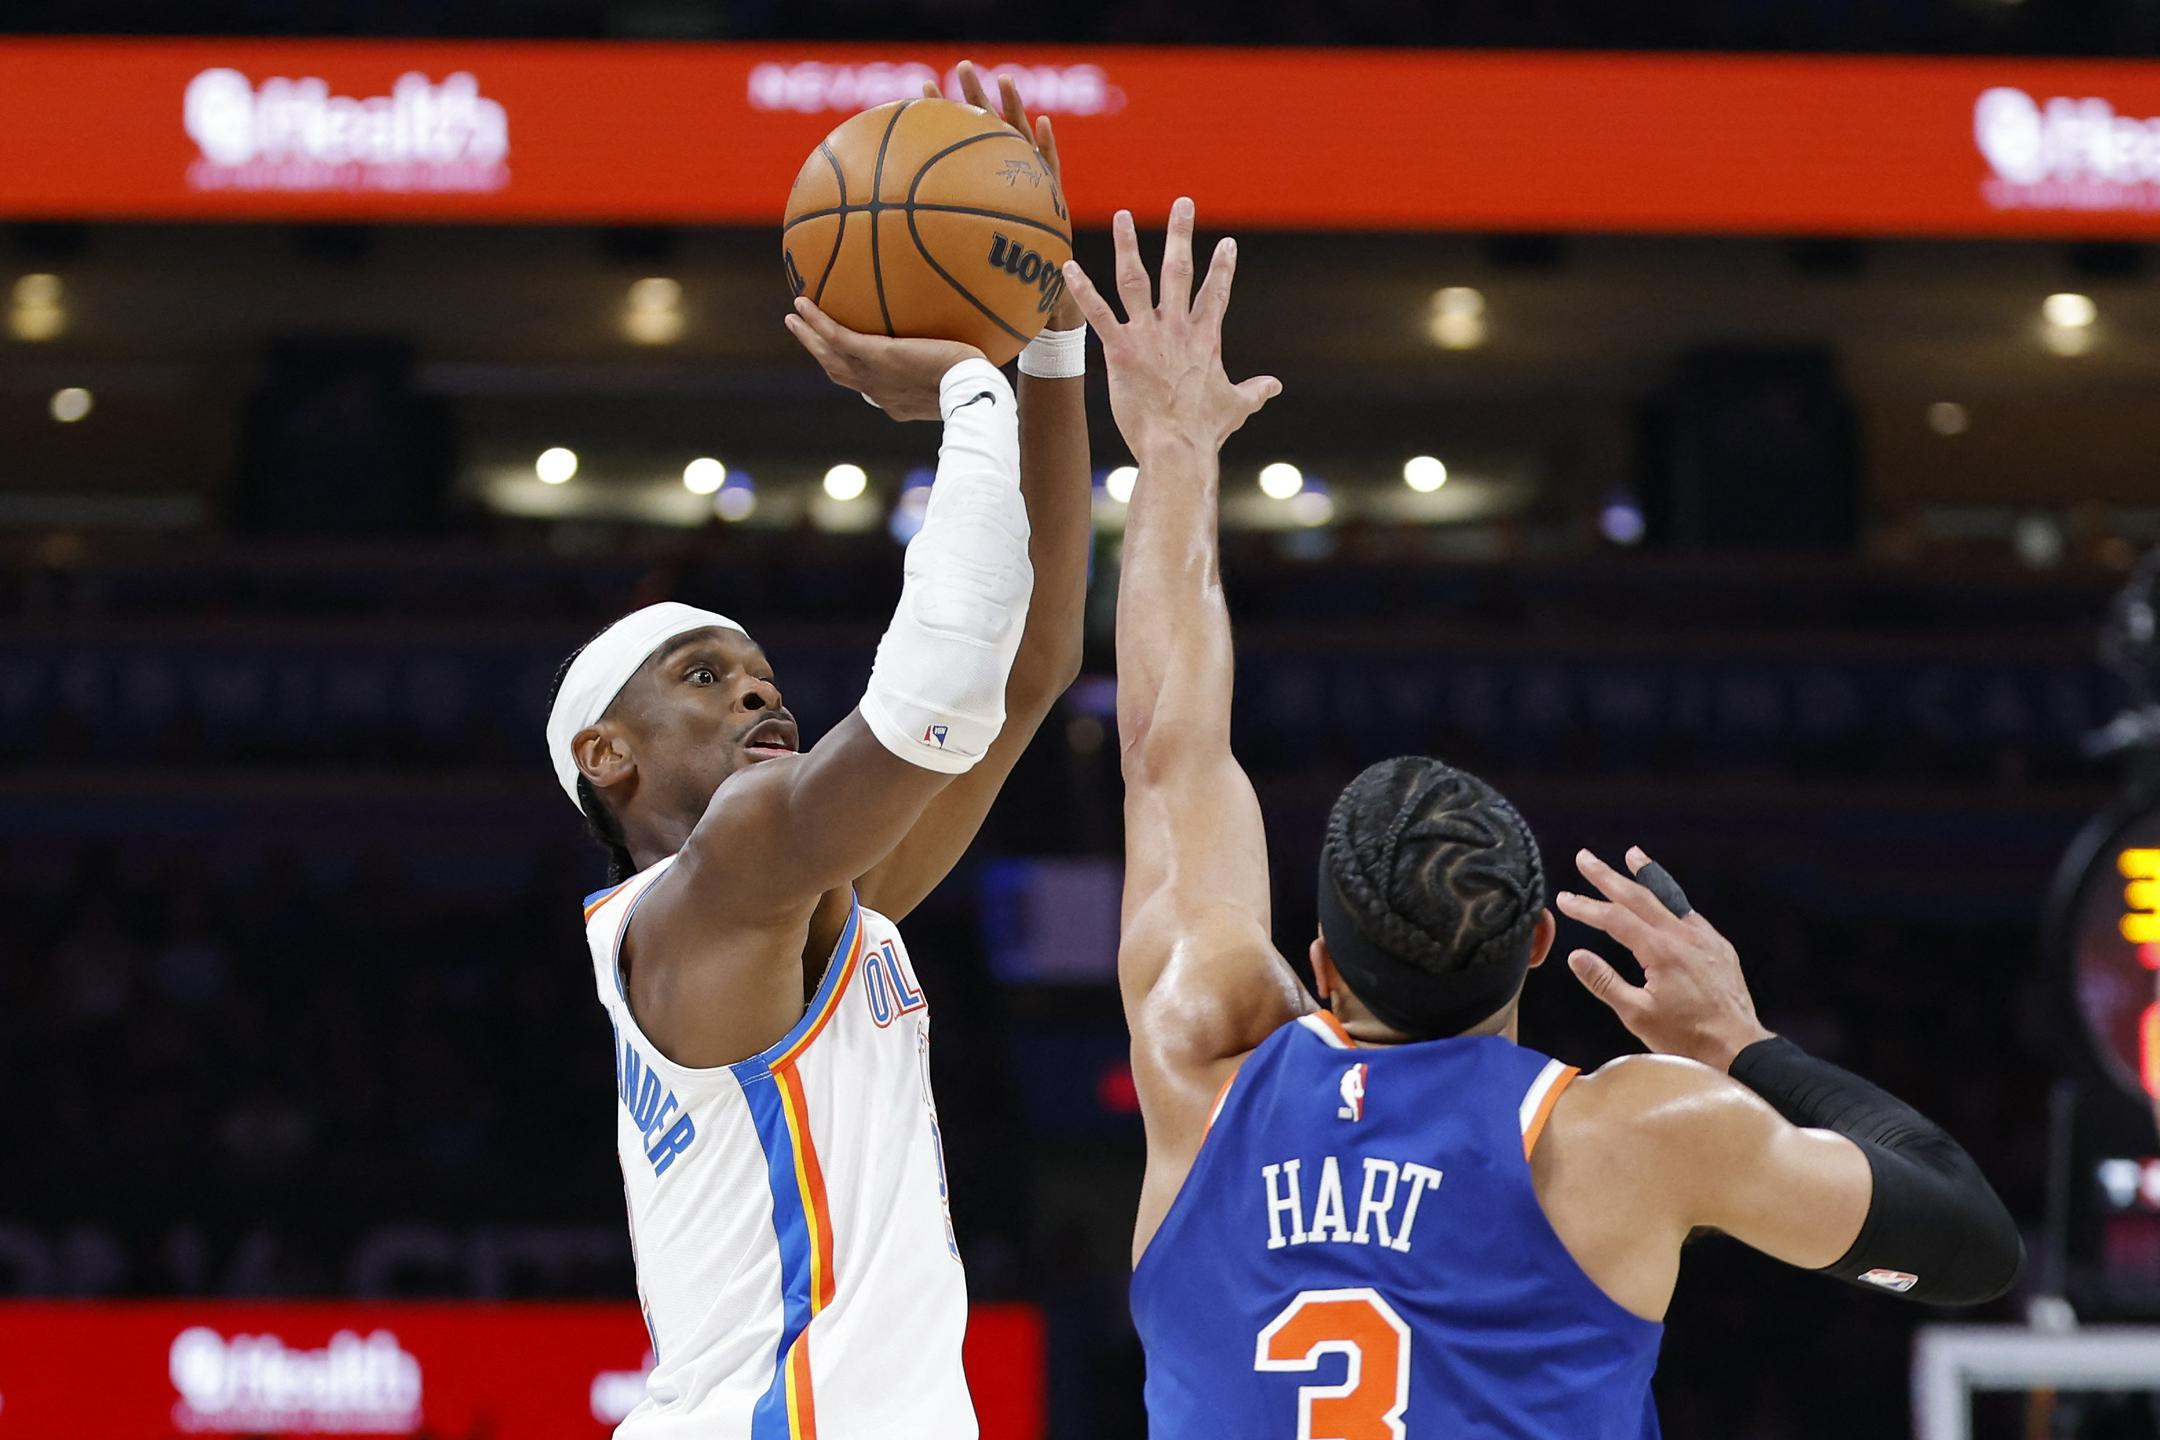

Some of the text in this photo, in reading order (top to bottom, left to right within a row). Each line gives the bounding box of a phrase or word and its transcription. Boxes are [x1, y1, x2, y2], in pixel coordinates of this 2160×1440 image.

[987, 231, 1067, 314] lson
[863, 939, 927, 1029] OL
[1261, 1156, 1443, 1253] HART
[1254, 1287, 1412, 1440] 3
